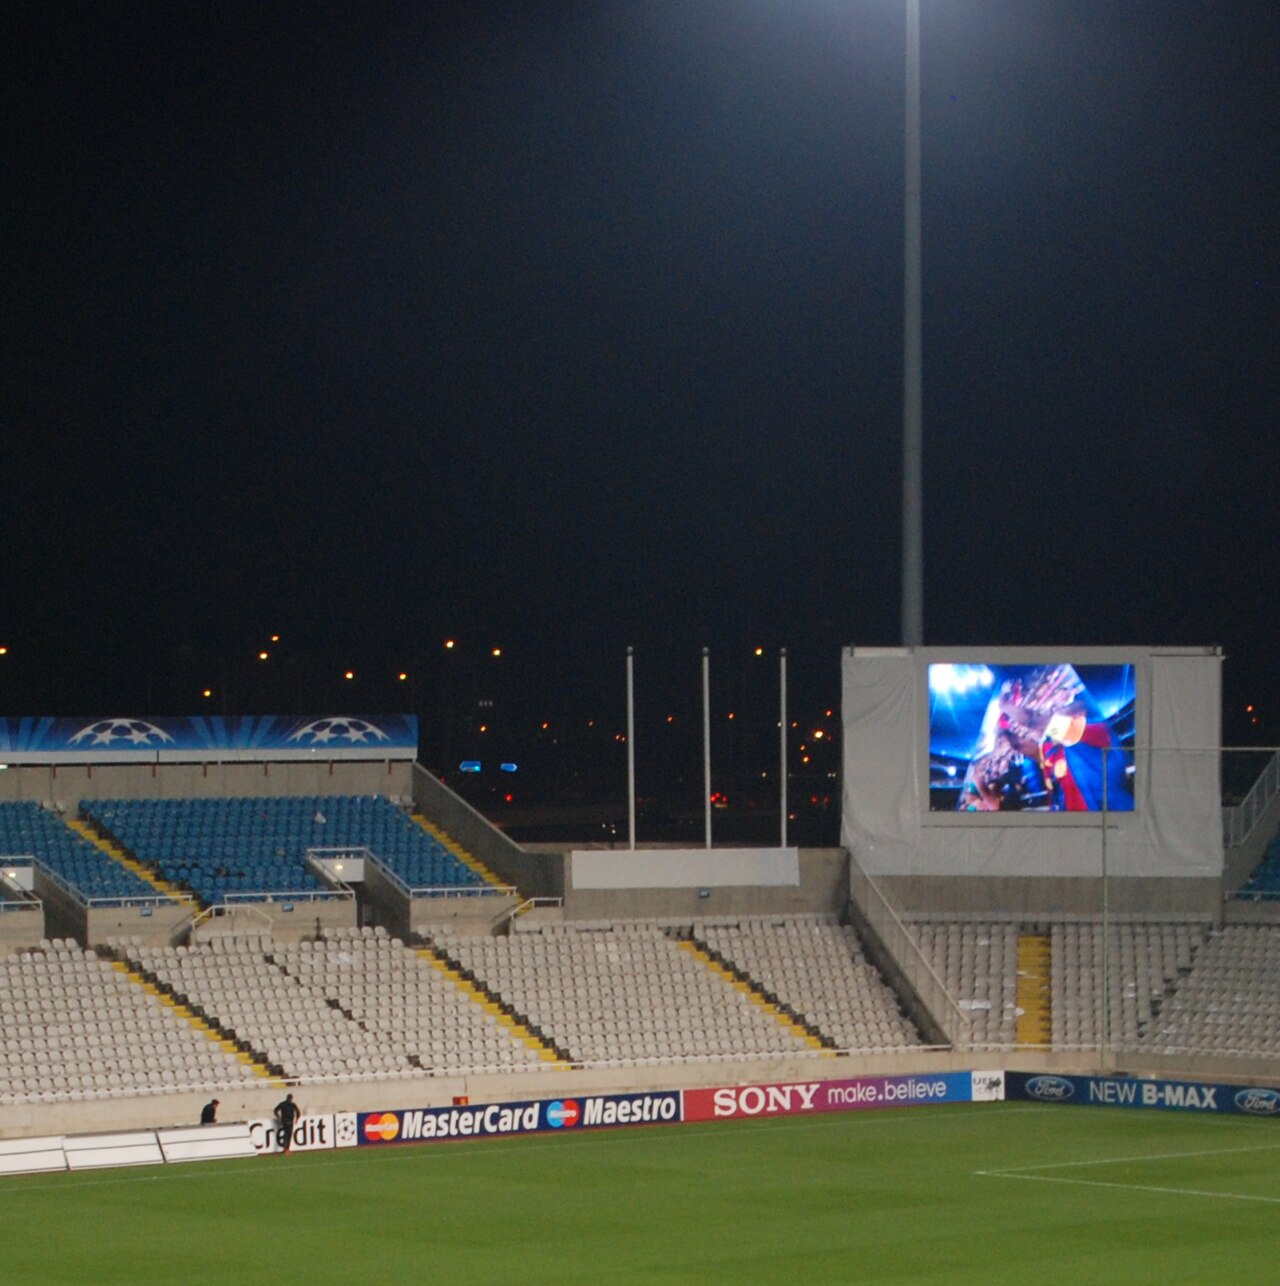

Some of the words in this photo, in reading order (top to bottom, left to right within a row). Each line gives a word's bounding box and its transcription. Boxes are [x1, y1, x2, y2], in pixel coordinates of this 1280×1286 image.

[714, 1084, 819, 1116] SONY
[828, 1079, 946, 1105] make.believe
[1090, 1081, 1137, 1103] NEW
[1142, 1084, 1217, 1109] B-MAX
[402, 1103, 539, 1139] MasterCard
[583, 1097, 676, 1125] Maestro
